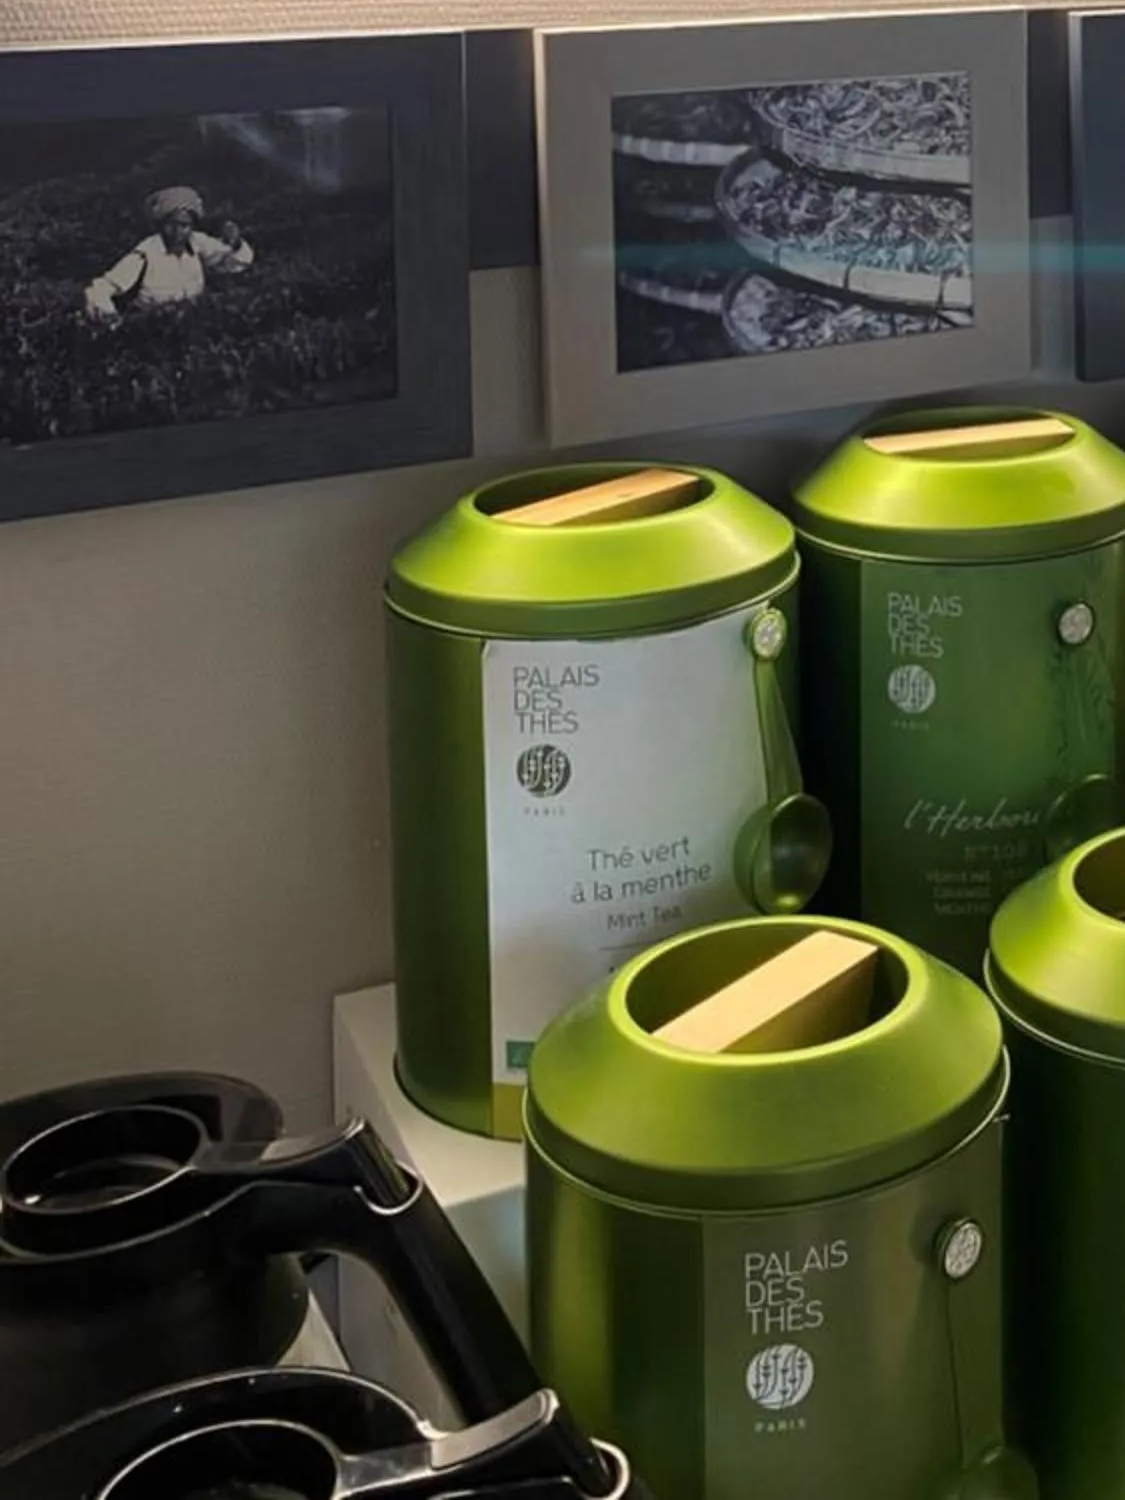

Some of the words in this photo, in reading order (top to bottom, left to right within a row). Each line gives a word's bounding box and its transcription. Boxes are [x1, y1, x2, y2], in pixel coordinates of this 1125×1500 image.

[887, 590, 963, 617] PALAIS
[888, 613, 931, 637] DES
[513, 663, 601, 689] PALAIS
[513, 688, 563, 712] DES
[588, 846, 635, 871] Thé
[641, 836, 690, 865] vert
[571, 882, 586, 904] à
[593, 881, 613, 902] la
[621, 863, 712, 899] menthe
[607, 911, 648, 931] Mint
[653, 904, 682, 923] Tea
[744, 1239, 849, 1281] PALAIS
[745, 1276, 805, 1308] DES
[754, 1417, 807, 1434] PARIS
